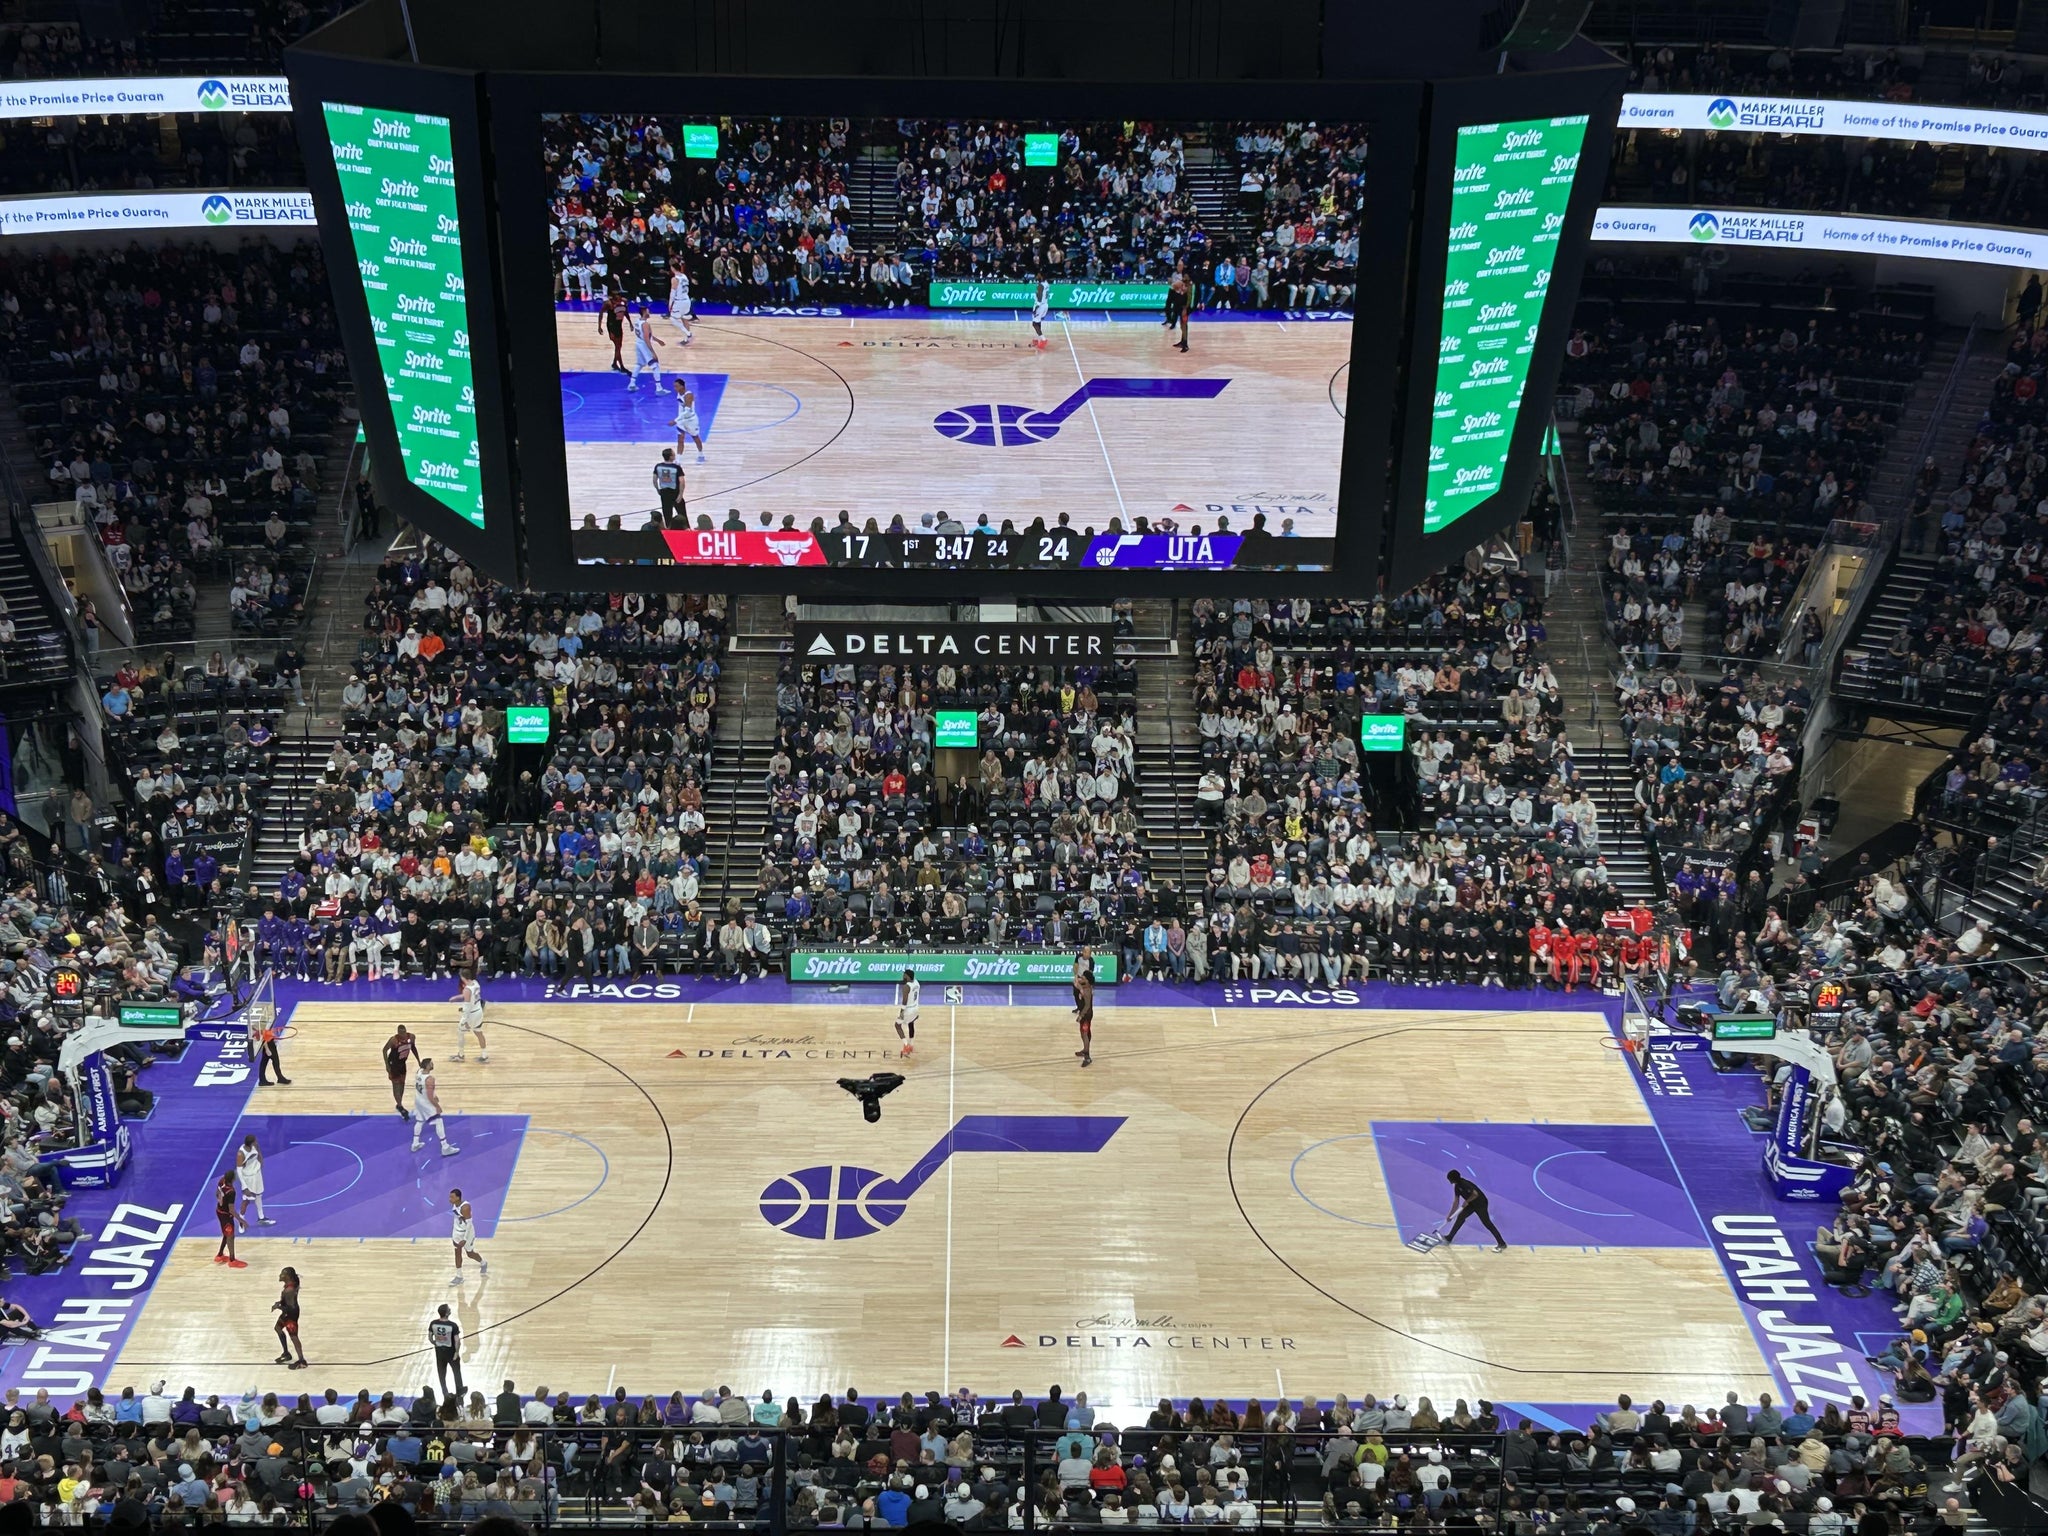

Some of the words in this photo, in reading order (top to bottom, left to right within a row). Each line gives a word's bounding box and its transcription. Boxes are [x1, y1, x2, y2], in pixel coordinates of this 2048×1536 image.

[230, 83, 266, 92] MARK
[6, 96, 27, 105] the
[30, 93, 78, 105] Promise
[82, 92, 114, 103] Price
[117, 92, 164, 102] Guaran
[1629, 106, 1674, 117] Guaran
[1741, 103, 1776, 113] MARK
[1779, 104, 1824, 116] MILLER
[372, 118, 411, 138] Sprite
[1740, 114, 1824, 128] SUBARU
[1844, 114, 1878, 126] Home
[1882, 116, 1896, 127] of
[1899, 117, 1919, 128] the
[1921, 120, 1971, 132] Promise
[1974, 123, 2006, 134] Price
[1502, 129, 1543, 151] Sprite
[381, 178, 419, 198] Sprite
[235, 198, 269, 207] MARK
[1494, 188, 1534, 209] Sprite
[13, 212, 33, 222] the
[36, 208, 84, 221] Promise
[88, 208, 119, 218] Price
[1722, 217, 1758, 228] MARK
[1760, 218, 1804, 230] MILLER
[1721, 228, 1803, 242] SUBARU
[1824, 228, 1858, 240] Home
[1861, 231, 1874, 242] of
[1877, 232, 1897, 244] the
[1900, 235, 1948, 248] Promise
[1952, 239, 1983, 251] Price
[1986, 242, 2032, 258] Guaran
[389, 236, 427, 256] Sprite
[1485, 245, 1526, 267] Sprite
[397, 294, 436, 314] Sprite
[941, 286, 986, 304] Sprite
[1069, 287, 1115, 305] Sprite
[1477, 302, 1517, 323] Sprite
[405, 350, 443, 370] Sprite
[1469, 357, 1509, 379] Sprite
[412, 405, 451, 425] Sprite
[1461, 411, 1501, 432] Sprite
[420, 460, 459, 478] Sprite
[1453, 465, 1493, 486] Sprite
[1206, 504, 1314, 514] DELTA
[698, 532, 736, 556] CHI
[842, 536, 869, 558] 17
[935, 537, 974, 559] 3:47
[987, 540, 1008, 556] 24
[1039, 537, 1069, 560] 24
[1168, 537, 1213, 560] UTA
[846, 635, 959, 654] DELTA
[974, 635, 1101, 654] CENTER
[514, 715, 544, 727] Sprite
[943, 720, 971, 730] Sprite
[1369, 724, 1398, 734] Sprite
[805, 956, 862, 977] Sprite
[868, 963, 889, 972] OBEY
[916, 964, 945, 972] THIRST
[964, 958, 1020, 978] Sprite
[1026, 964, 1049, 973] OBEY
[56, 983, 76, 994] 24
[571, 984, 681, 998] PACS
[1250, 989, 1360, 1004] PACS
[1818, 994, 1837, 1007] 24
[123, 1011, 145, 1020] Sprite
[700, 1050, 791, 1058] DELTA
[90, 1067, 102, 1091] FIRST
[1650, 1053, 1693, 1095] EALTH
[95, 1091, 107, 1132] AMERICA
[1712, 1216, 1817, 1301] UTAH
[16, 1298, 134, 1395] UTAH
[80, 1204, 183, 1290] JAZZ
[1039, 1335, 1151, 1347] DELTA
[1167, 1336, 1296, 1349] CENTER
[1757, 1310, 1870, 1407] JAZZ
